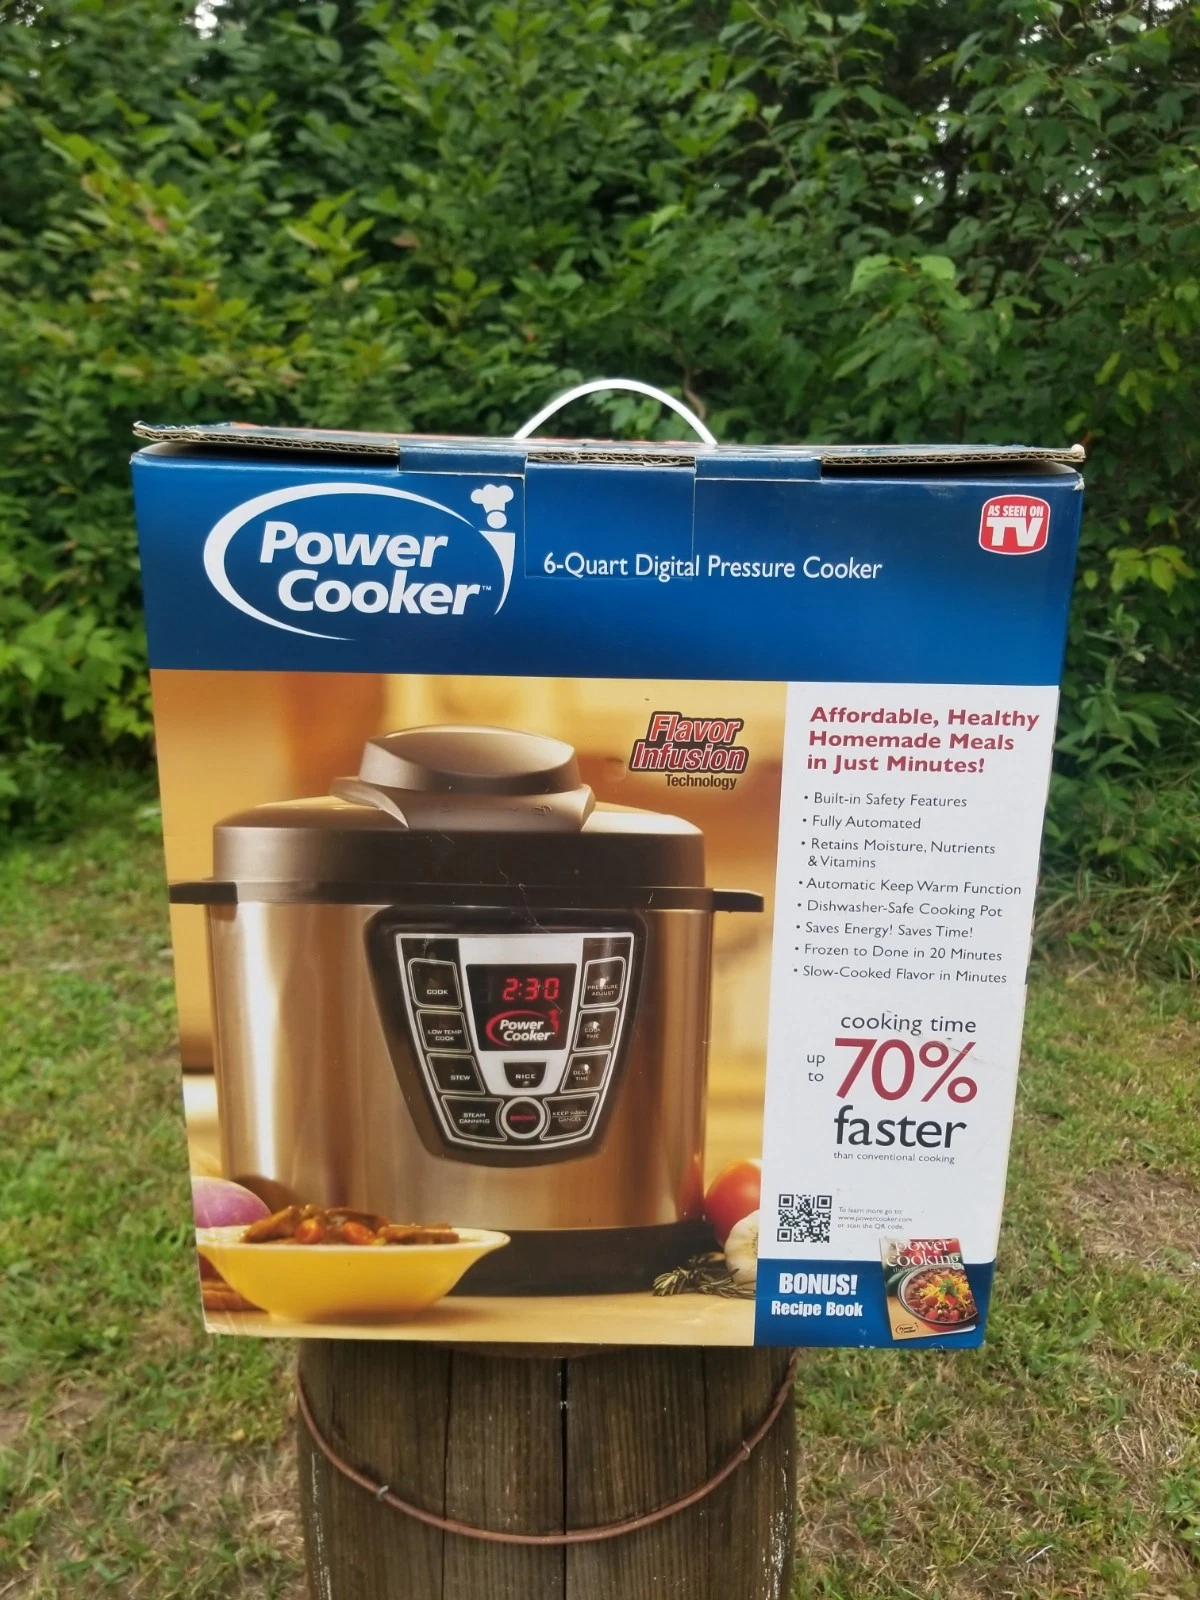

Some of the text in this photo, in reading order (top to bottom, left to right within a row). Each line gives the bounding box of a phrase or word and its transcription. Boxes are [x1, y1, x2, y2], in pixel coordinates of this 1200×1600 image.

[988, 505, 1044, 517] AS SEEN ON
[986, 516, 1044, 547] TV
[260, 521, 448, 568] Power
[543, 552, 883, 583] 6-Quart Digital Pressure Cooker
[278, 570, 480, 616] Cooker
[809, 706, 1040, 731] Affordable, Healthy
[648, 714, 741, 743] Flavor
[809, 730, 1015, 751] Homemade Meals
[632, 742, 746, 771] Infusion
[807, 754, 985, 774] in Just Minutes!
[665, 774, 737, 790] Technology
[814, 792, 967, 808] Built-in Safety Features
[812, 815, 921, 830] Fully Automated
[811, 838, 996, 854] Retains Moisture, Nutrients
[807, 855, 876, 868] & Vitamins
[806, 878, 1022, 895] Automatic Keep Warm Function
[807, 900, 1003, 919] Dishwasher-Safe Cooking Pot
[805, 922, 973, 938] Saves Energy! Saves Time!
[804, 944, 1002, 961] Frozen to Done in 20 Minutes
[803, 965, 1007, 984] Slow-Cooked Flavor in Minutes
[502, 978, 560, 1000] 2:30
[499, 1019, 544, 1032] Power
[840, 1013, 977, 1036] cooking time
[503, 1030, 550, 1042] Cooker
[806, 1054, 825, 1067] up
[808, 1071, 824, 1082] to
[834, 1037, 978, 1104] 70%
[833, 1104, 968, 1148] faster
[833, 1152, 955, 1165] than conventional cooking
[895, 1240, 950, 1255] power
[886, 1250, 960, 1270] cooking
[778, 1272, 858, 1295] BONUS!
[771, 1300, 864, 1317] Recipe Book
